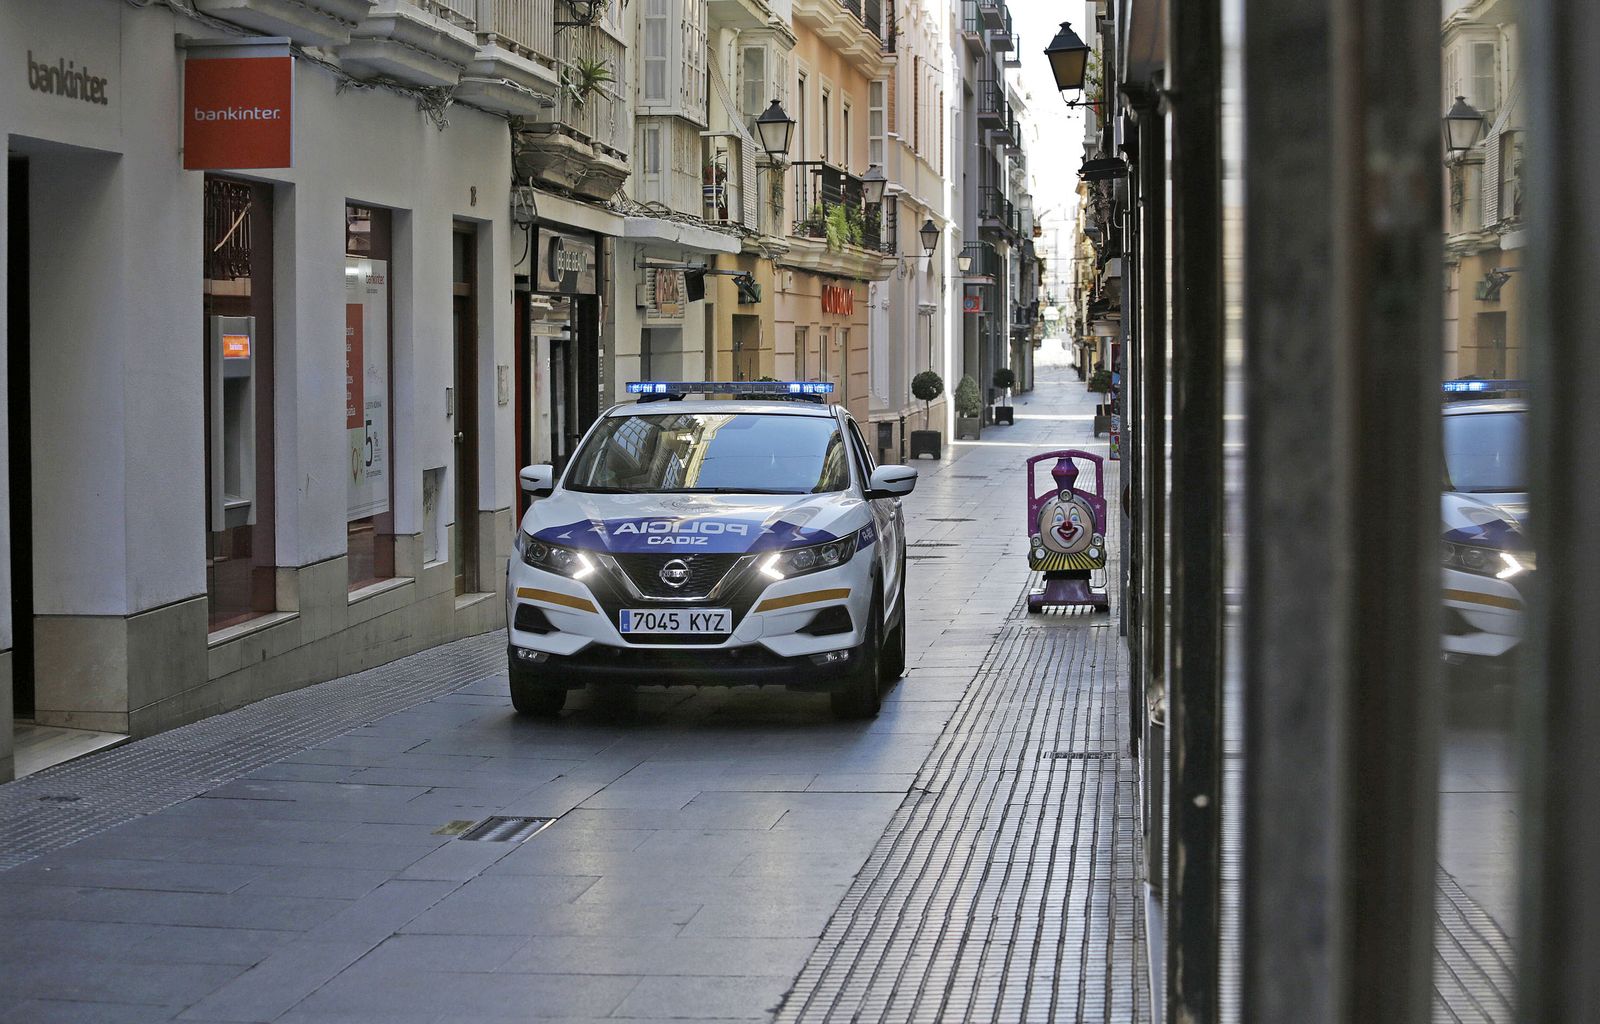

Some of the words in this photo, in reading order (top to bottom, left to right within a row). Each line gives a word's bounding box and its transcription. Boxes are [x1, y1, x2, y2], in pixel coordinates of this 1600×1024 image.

[194, 107, 281, 121] bankinter.
[647, 536, 709, 545] CADIZ
[633, 612, 680, 631] 7045
[689, 613, 725, 631] KYZ
